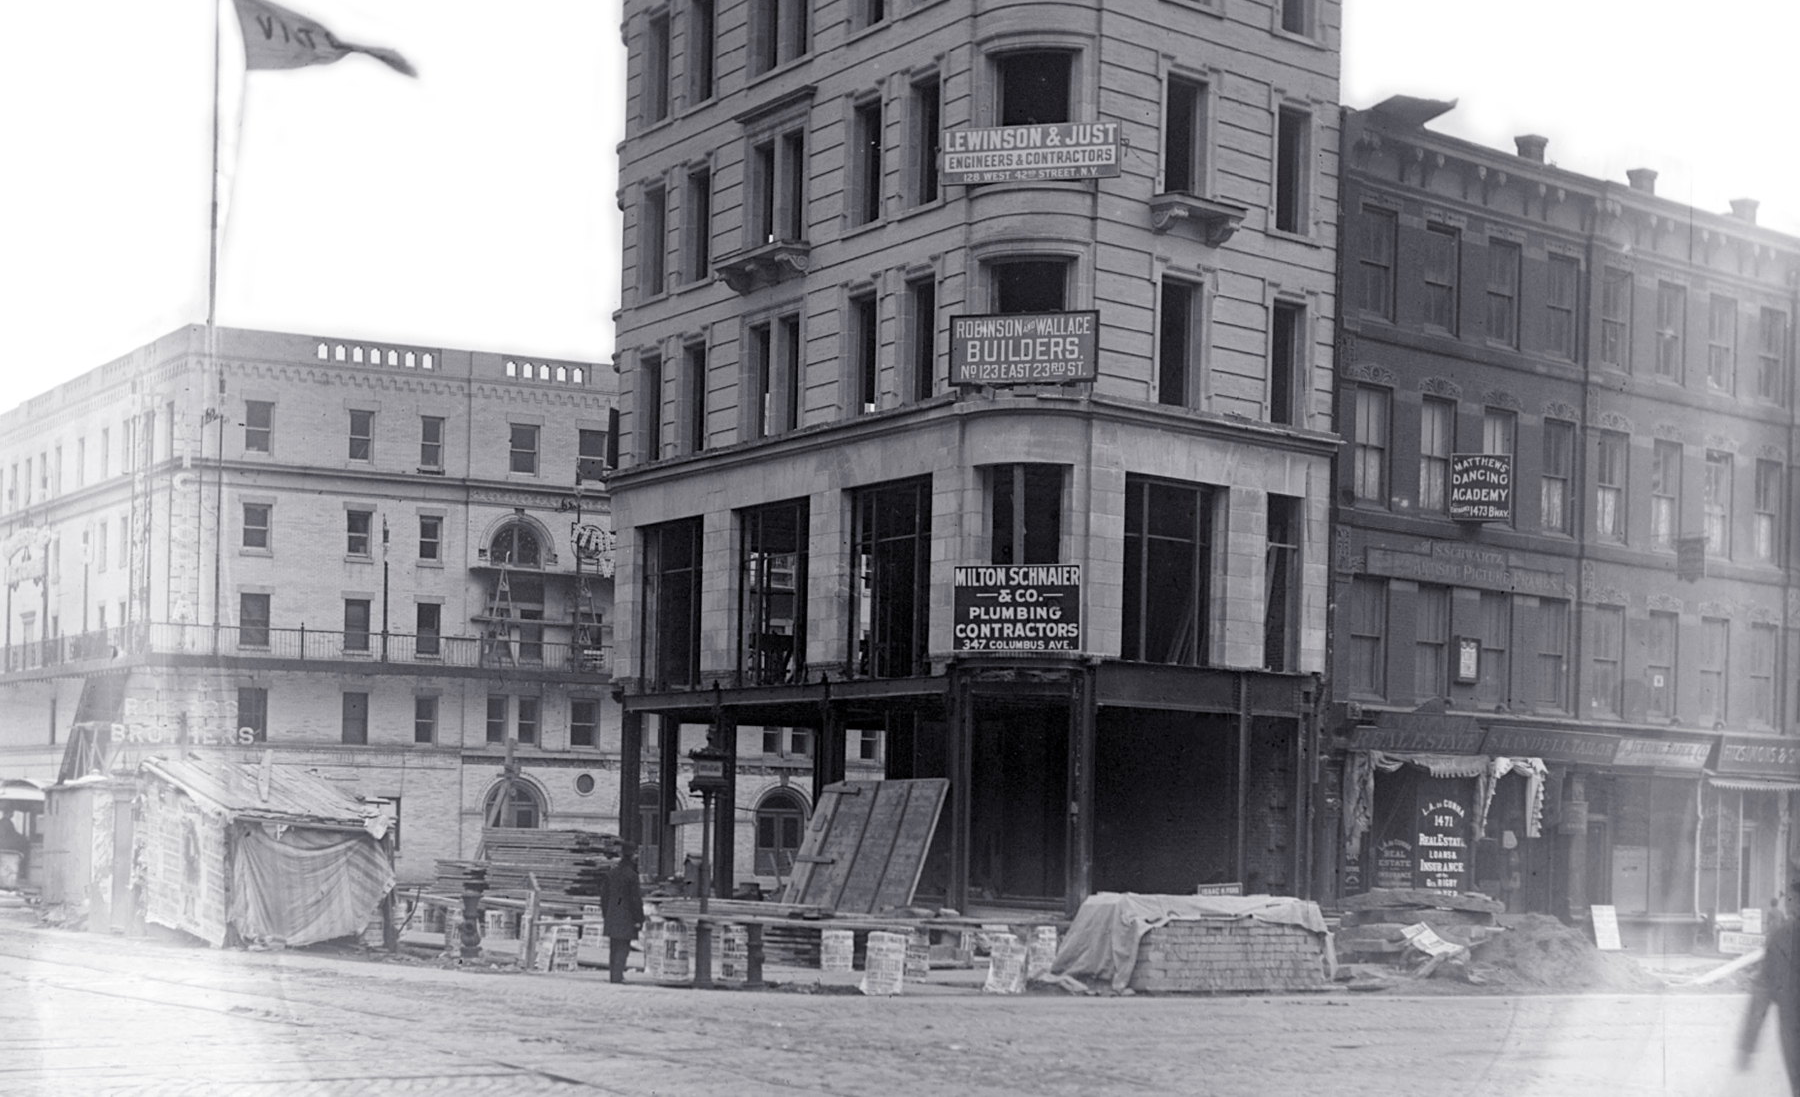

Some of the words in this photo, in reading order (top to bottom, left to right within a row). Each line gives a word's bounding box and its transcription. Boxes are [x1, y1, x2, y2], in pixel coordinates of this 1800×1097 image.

[945, 127, 1042, 152] LEWINSON
[1046, 126, 1061, 146] &
[1065, 123, 1117, 146] JUST
[949, 153, 1013, 170] ENGINEERS
[1015, 153, 1024, 166] &
[1025, 148, 1112, 166] CONTRACTORS
[963, 172, 980, 182] 128
[983, 170, 1011, 181] WEST
[1081, 166, 1098, 177] N.Y.
[956, 319, 1023, 339] ROBINSON
[1023, 320, 1036, 333] AND
[1036, 316, 1091, 335] WALLACE
[967, 337, 1084, 363] BUILDERS.
[979, 365, 999, 379] 123
[1001, 364, 1031, 379] EAST
[1033, 362, 1066, 377] 23RD
[1067, 362, 1087, 376] ST.
[1453, 469, 1509, 485] DANCING
[1452, 487, 1509, 502] ACADEMY
[1470, 505, 1488, 517] 1473
[955, 567, 1007, 587] MILTON
[1009, 566, 1080, 586] SCHNAIER
[1413, 559, 1462, 578] ARTISTIC
[1463, 564, 1510, 584] PICTURE
[998, 589, 1012, 602] &
[1015, 589, 1044, 602] CO.
[969, 607, 1062, 620] PLUMBING
[955, 623, 1078, 638] CONTRACTORS
[962, 639, 987, 650] 347
[989, 640, 1045, 649] COLUMBUS
[1048, 640, 1074, 649] AVE.
[1434, 815, 1453, 827] 1471
[1420, 858, 1465, 872] INSURANCE
